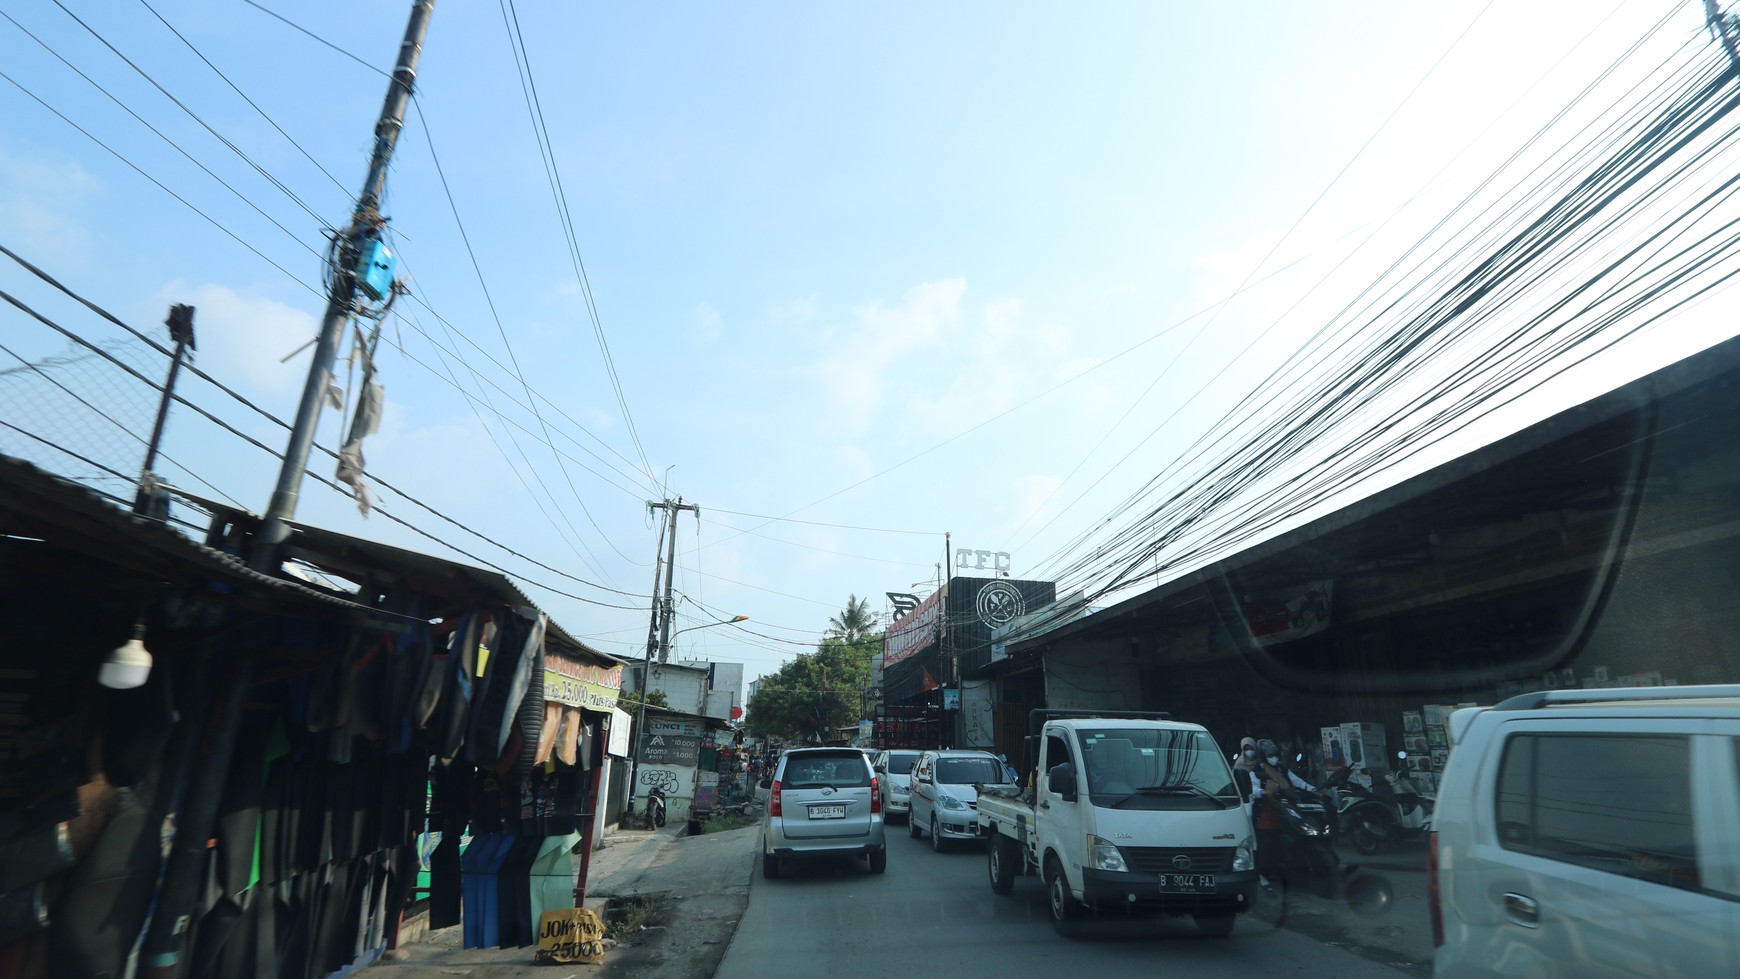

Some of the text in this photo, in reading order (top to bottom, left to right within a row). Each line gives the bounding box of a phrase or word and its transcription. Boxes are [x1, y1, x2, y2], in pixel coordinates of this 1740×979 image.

[957, 549, 1010, 571] TFC
[650, 723, 681, 731] KUNCI
[644, 747, 668, 755] Aroma
[1160, 874, 1216, 887] B 9044 FAJ
